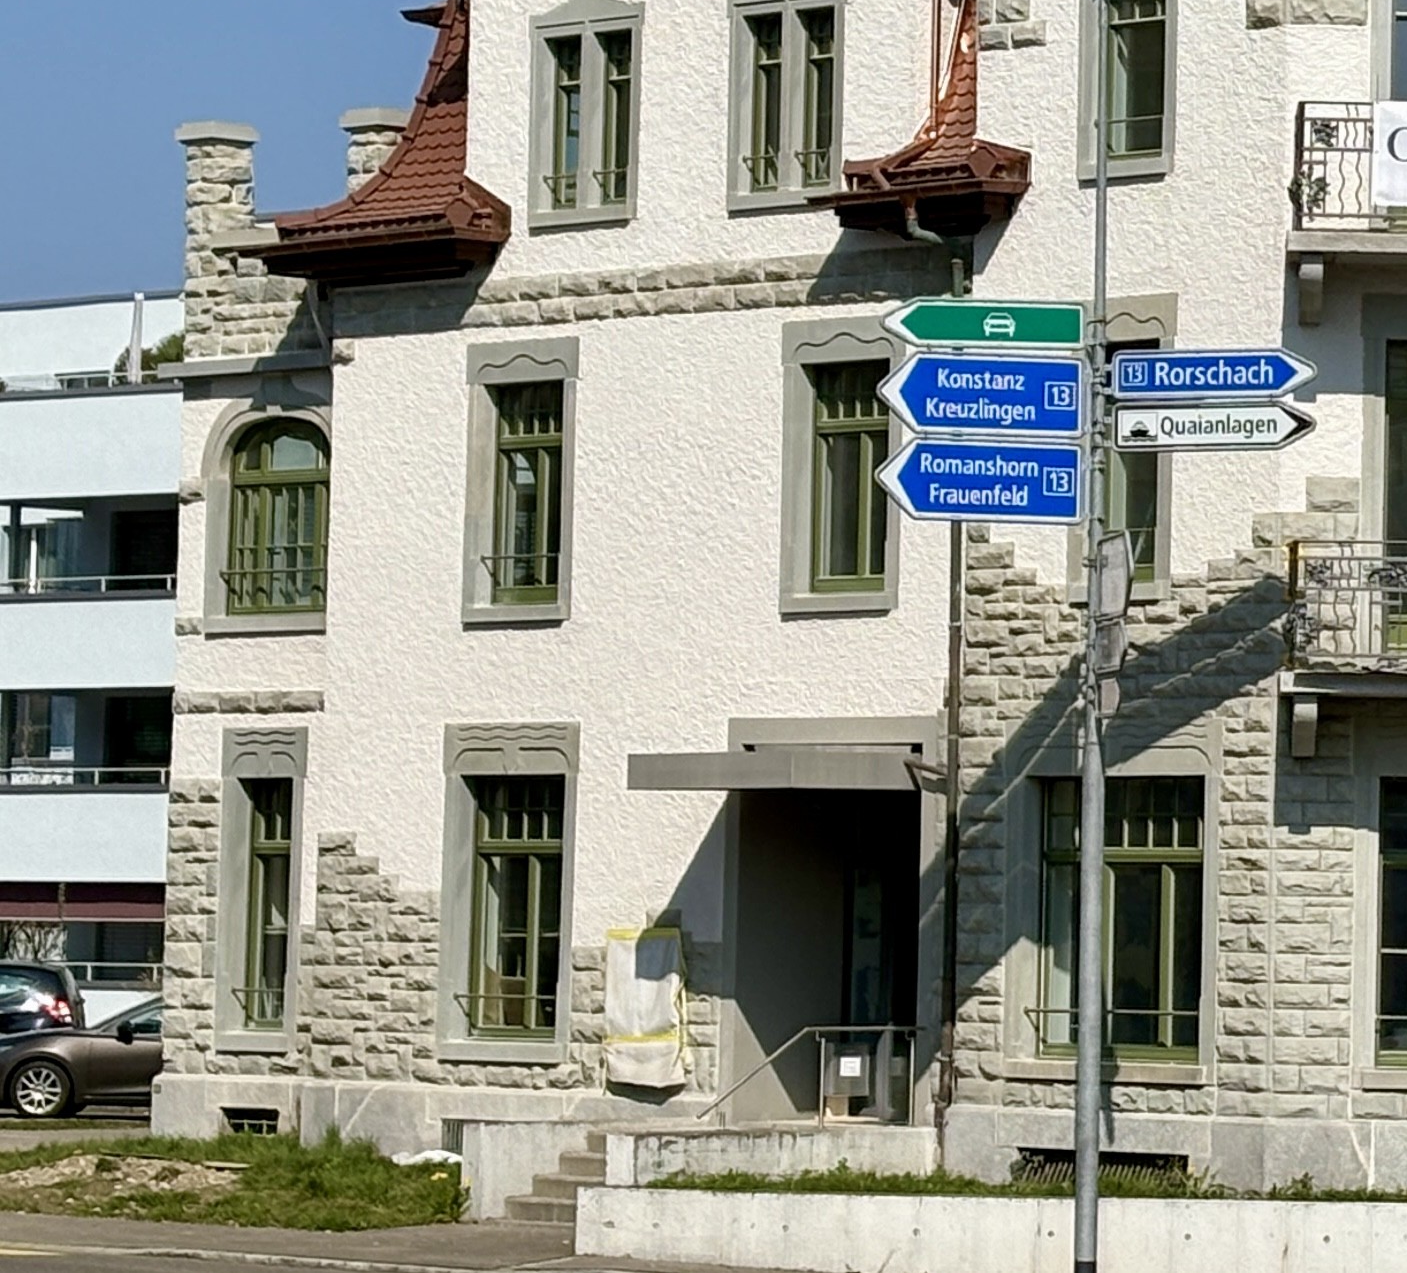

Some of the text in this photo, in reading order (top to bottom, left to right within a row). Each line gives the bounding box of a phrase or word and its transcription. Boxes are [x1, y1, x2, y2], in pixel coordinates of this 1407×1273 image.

[937, 368, 1025, 391] Konstanz
[1126, 360, 1274, 386] 13 Rorschach
[1051, 387, 1070, 406] 13
[925, 397, 1036, 425] Kreuzlingen
[1160, 412, 1277, 438] Quaianlagen
[920, 453, 1039, 478] Romanshorn
[1050, 473, 1068, 492] 13
[929, 483, 1028, 507] Frauenfeld
